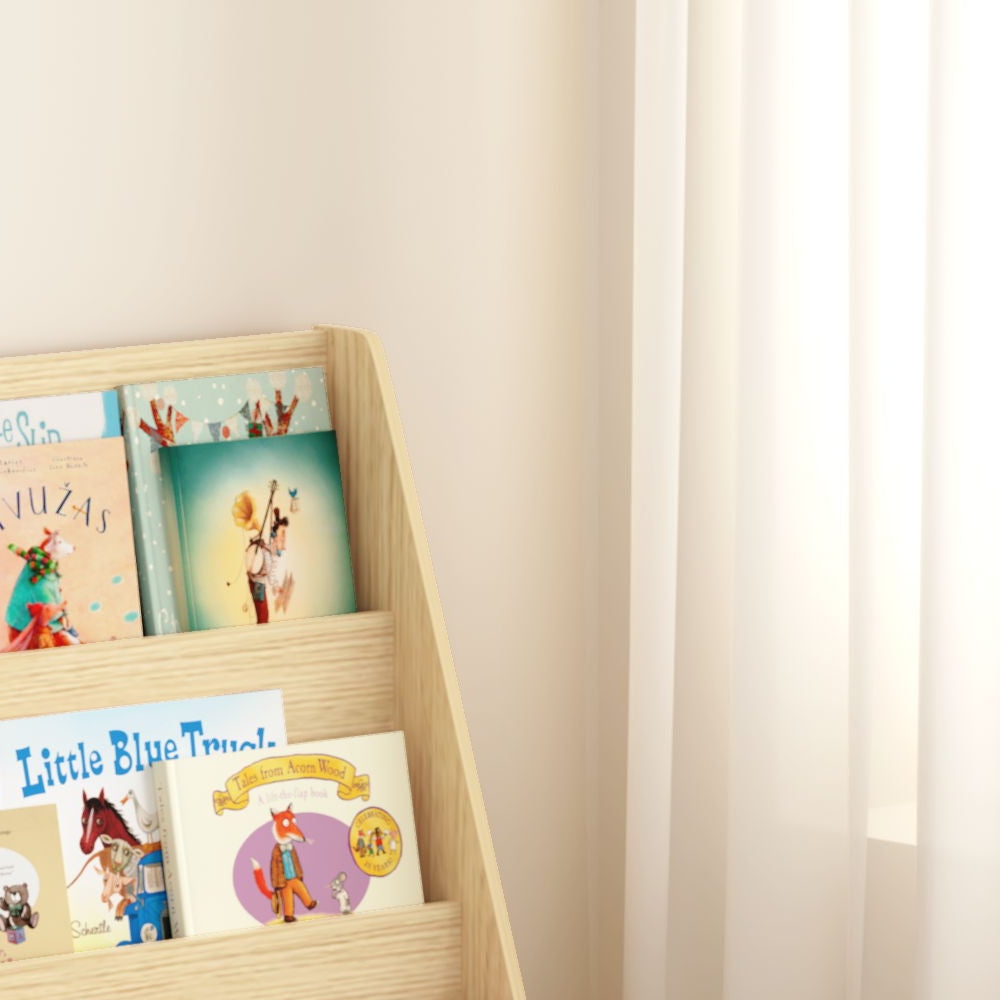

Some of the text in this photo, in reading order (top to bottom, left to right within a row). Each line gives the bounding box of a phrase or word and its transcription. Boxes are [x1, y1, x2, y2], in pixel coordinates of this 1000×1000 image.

[16, 742, 104, 798] Little
[108, 729, 179, 775] Blue
[232, 758, 347, 792] Tales from Acorn Wood
